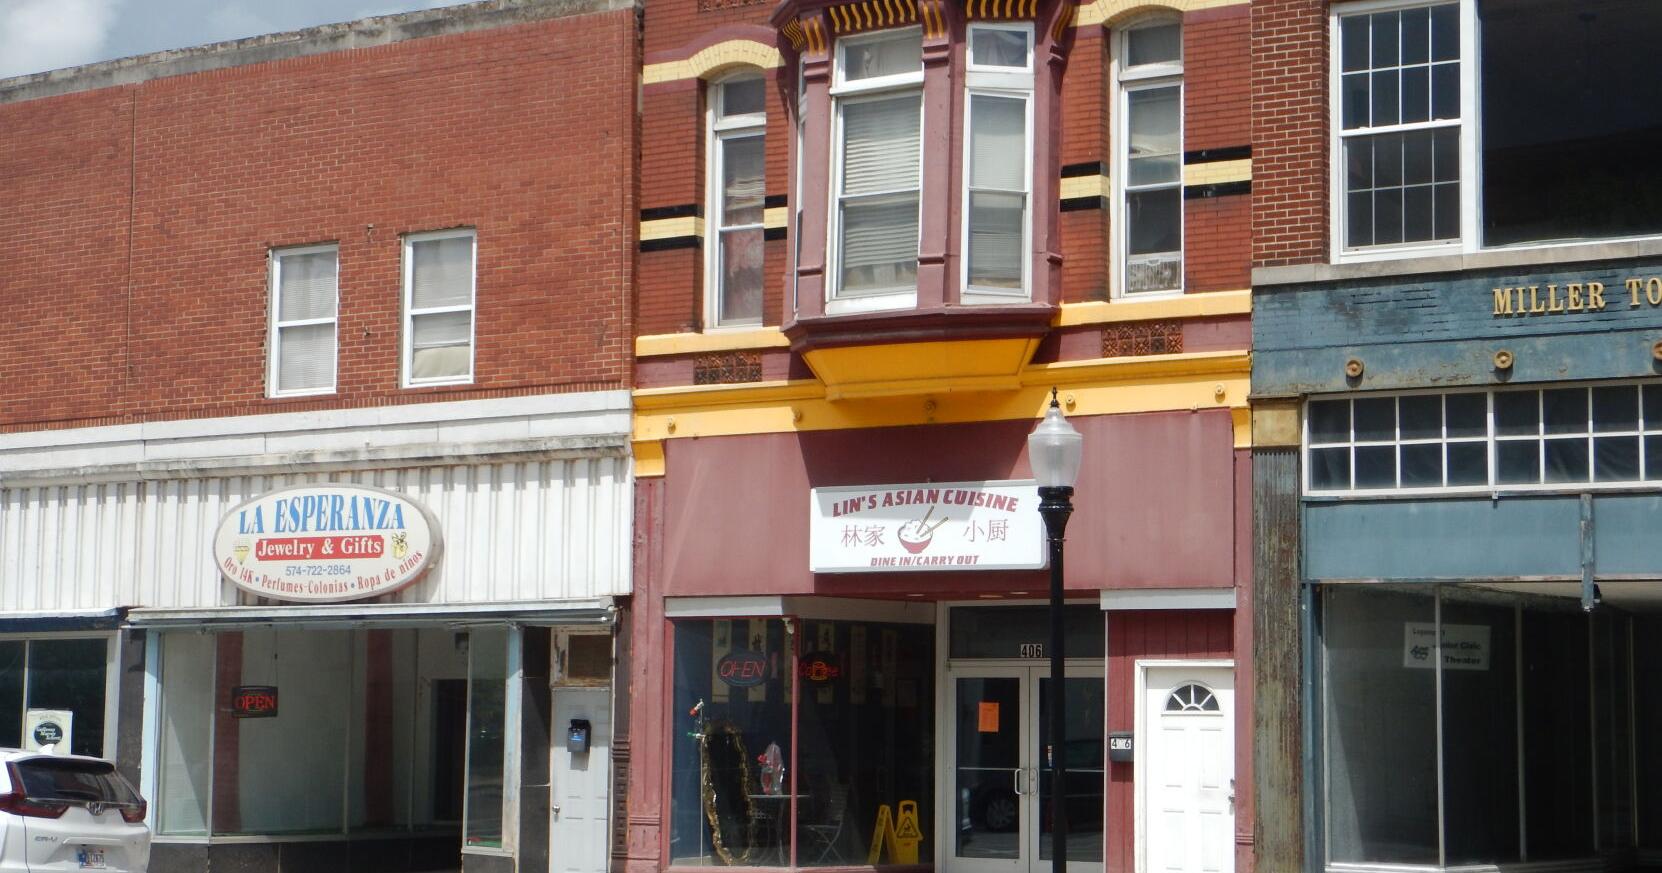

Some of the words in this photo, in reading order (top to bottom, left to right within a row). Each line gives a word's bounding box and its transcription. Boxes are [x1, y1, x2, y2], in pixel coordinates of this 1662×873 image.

[1492, 282, 1606, 315] MILLER
[239, 504, 264, 534] LA
[274, 494, 405, 533] ESPERANZA
[832, 494, 877, 517] LIN'S
[882, 489, 940, 507] ASIAN
[942, 489, 1019, 512] CUISINE
[840, 524, 886, 548] 林家
[962, 518, 1009, 543] 小厨
[258, 539, 315, 558] Jewelry
[321, 539, 335, 555] &
[341, 536, 382, 554] Gifts
[223, 556, 238, 575] Oro
[239, 567, 254, 584] 14K
[357, 574, 381, 590] Ropa
[384, 568, 396, 581] de
[286, 564, 351, 576] 574-722-2864
[870, 557, 896, 567] DINE
[956, 554, 980, 565] OUT
[1021, 645, 1041, 657] 406
[234, 695, 274, 709] OPEN
